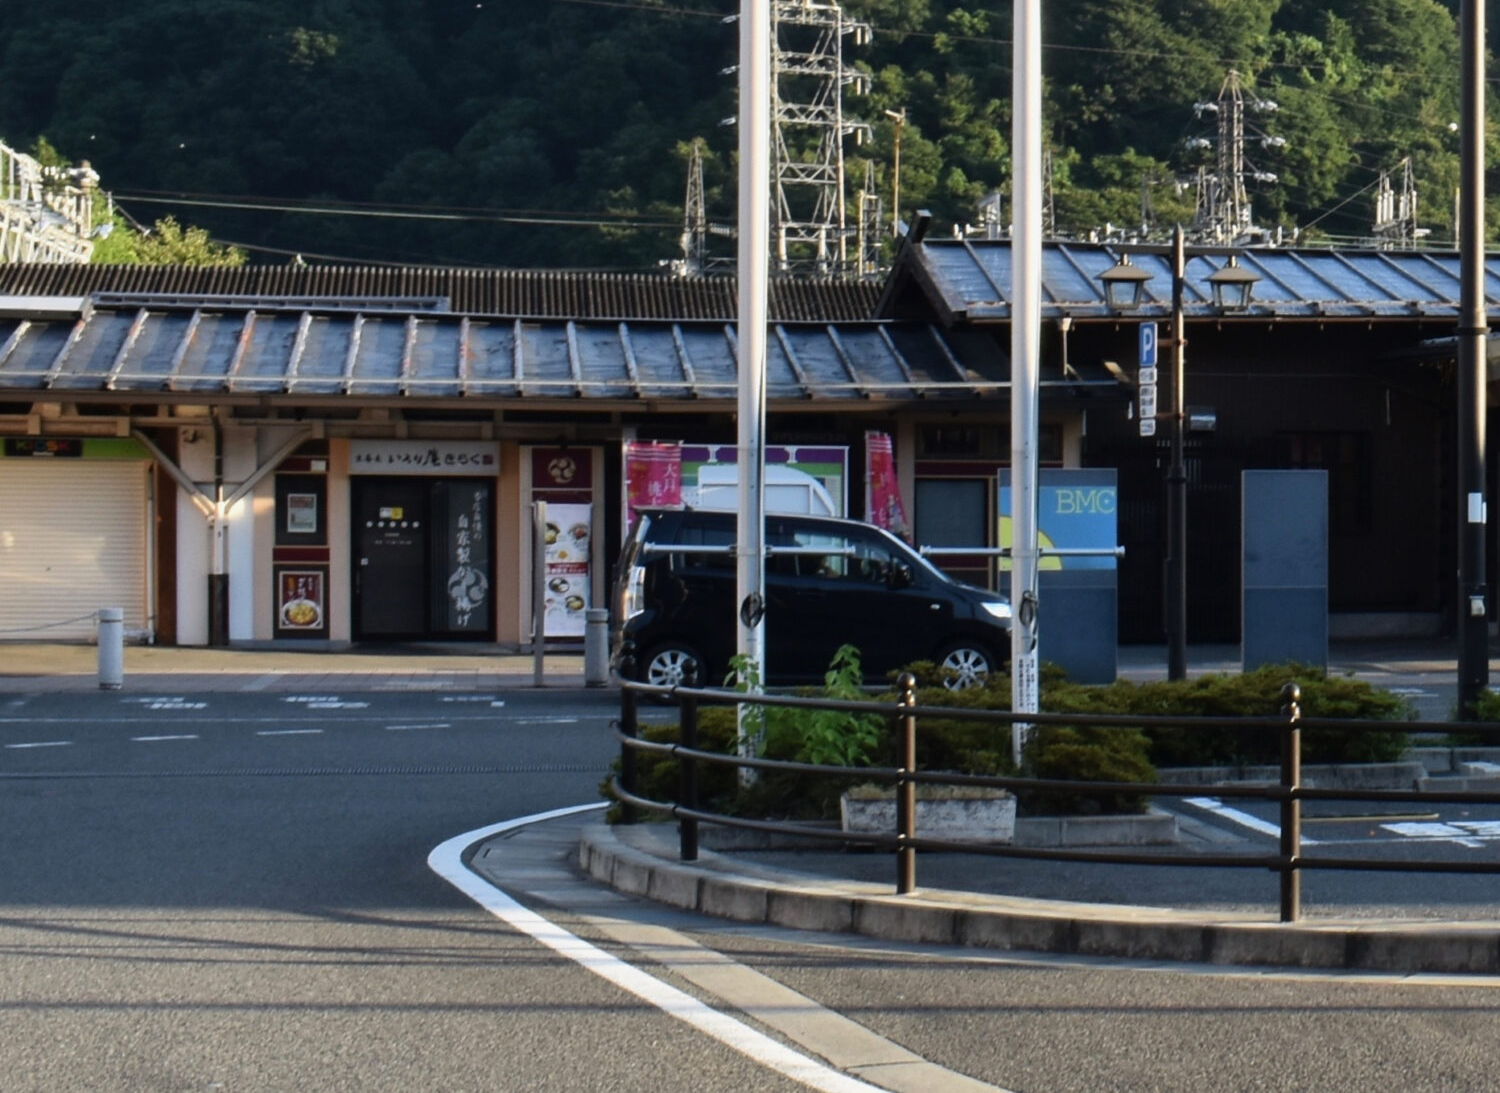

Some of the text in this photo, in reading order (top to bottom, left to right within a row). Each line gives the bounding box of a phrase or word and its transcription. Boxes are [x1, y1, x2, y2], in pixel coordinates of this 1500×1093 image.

[1142, 327, 1153, 362] P
[663, 463, 678, 494] 大月
[1056, 489, 1117, 514] BMC
